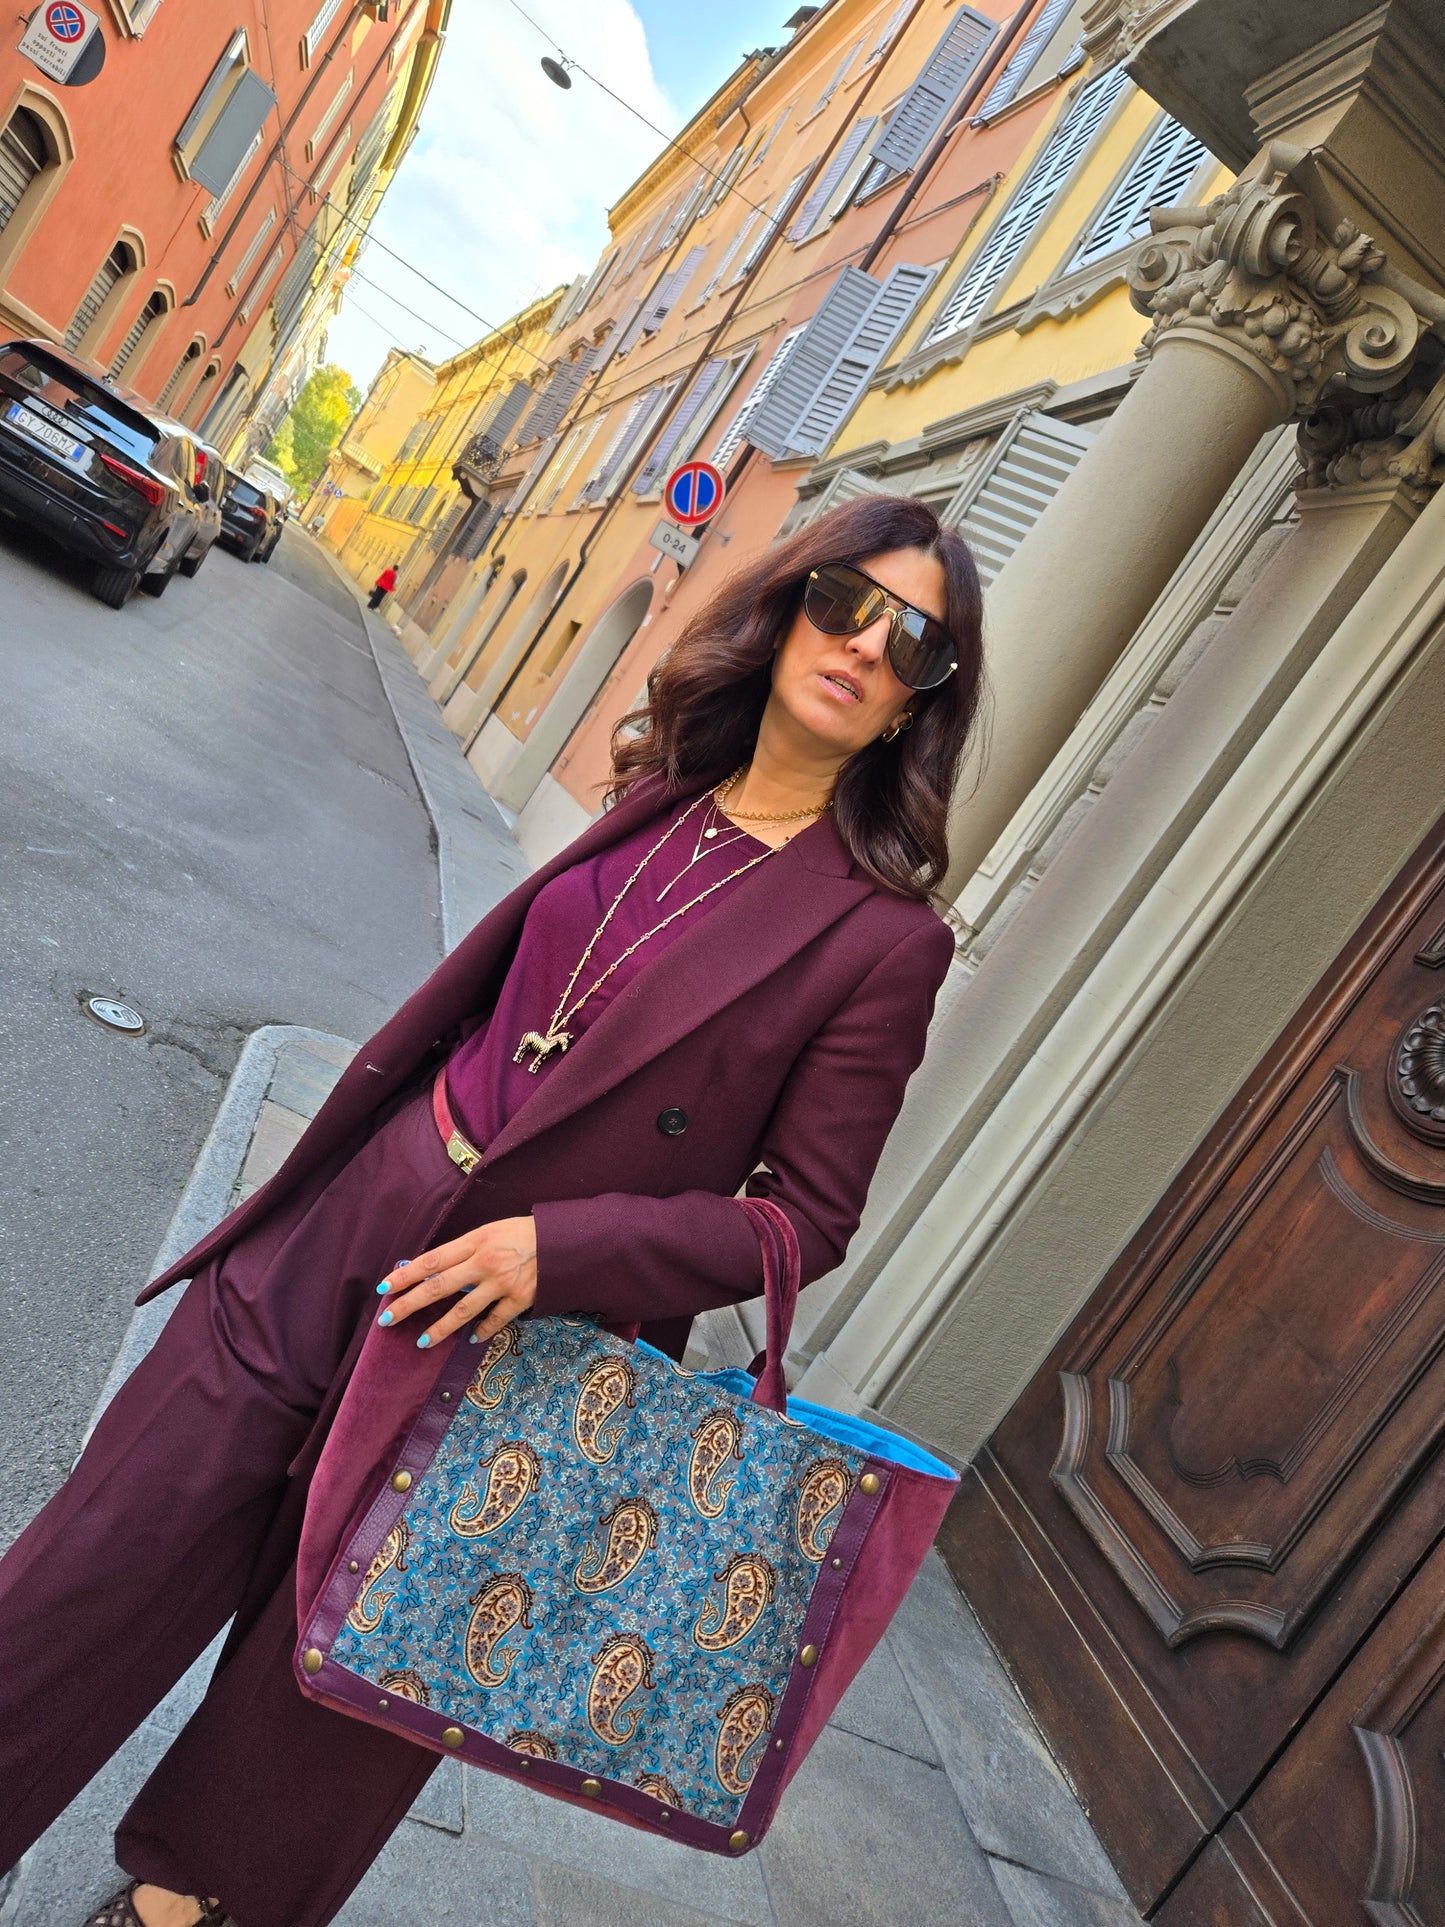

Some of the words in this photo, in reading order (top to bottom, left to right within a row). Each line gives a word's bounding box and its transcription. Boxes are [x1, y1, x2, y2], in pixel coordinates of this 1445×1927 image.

[32, 39, 55, 58] opposti
[49, 40, 68, 57] fronti
[662, 533, 686, 554] 0-24
